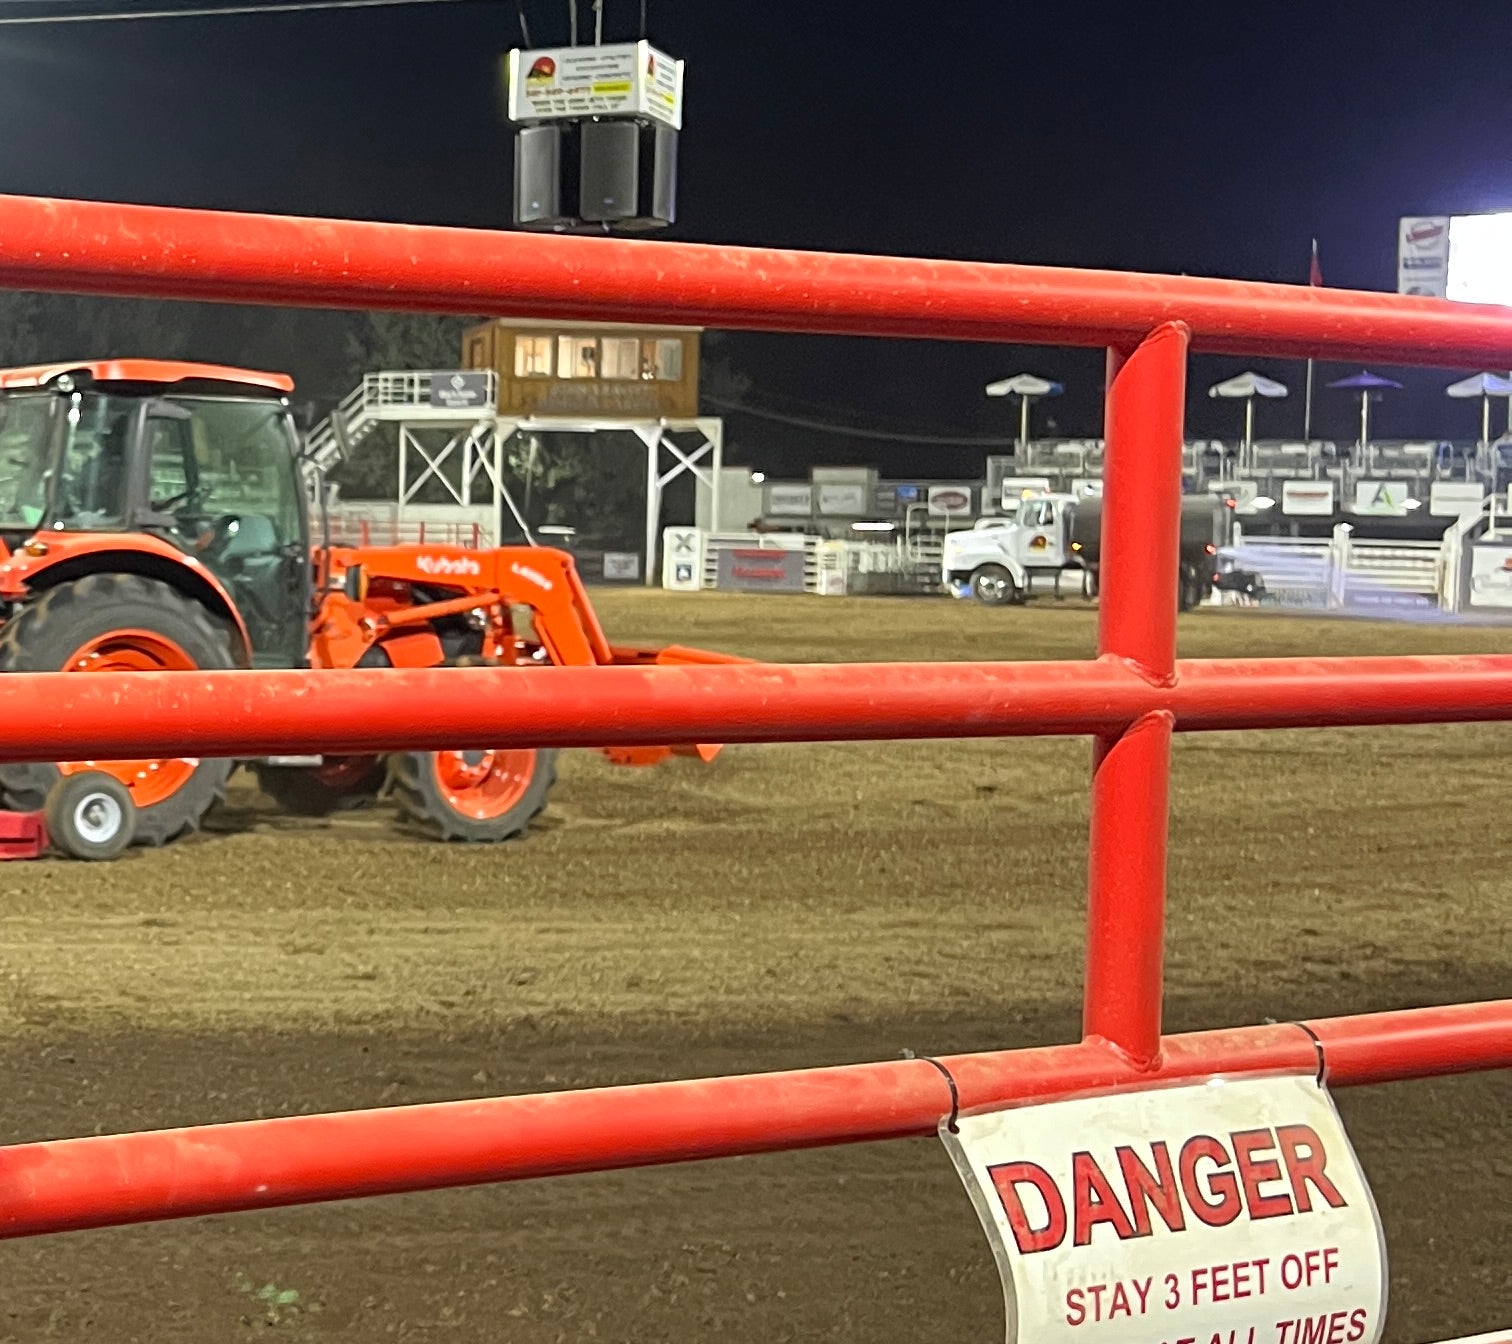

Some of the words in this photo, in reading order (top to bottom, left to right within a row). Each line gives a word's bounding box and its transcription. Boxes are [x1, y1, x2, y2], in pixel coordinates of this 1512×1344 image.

[985, 1123, 1349, 1255] DANGER
[1065, 1276, 1153, 1326] STAY
[1163, 1272, 1181, 1310] 3
[1191, 1258, 1270, 1306] FEET
[1280, 1247, 1339, 1290] OFF
